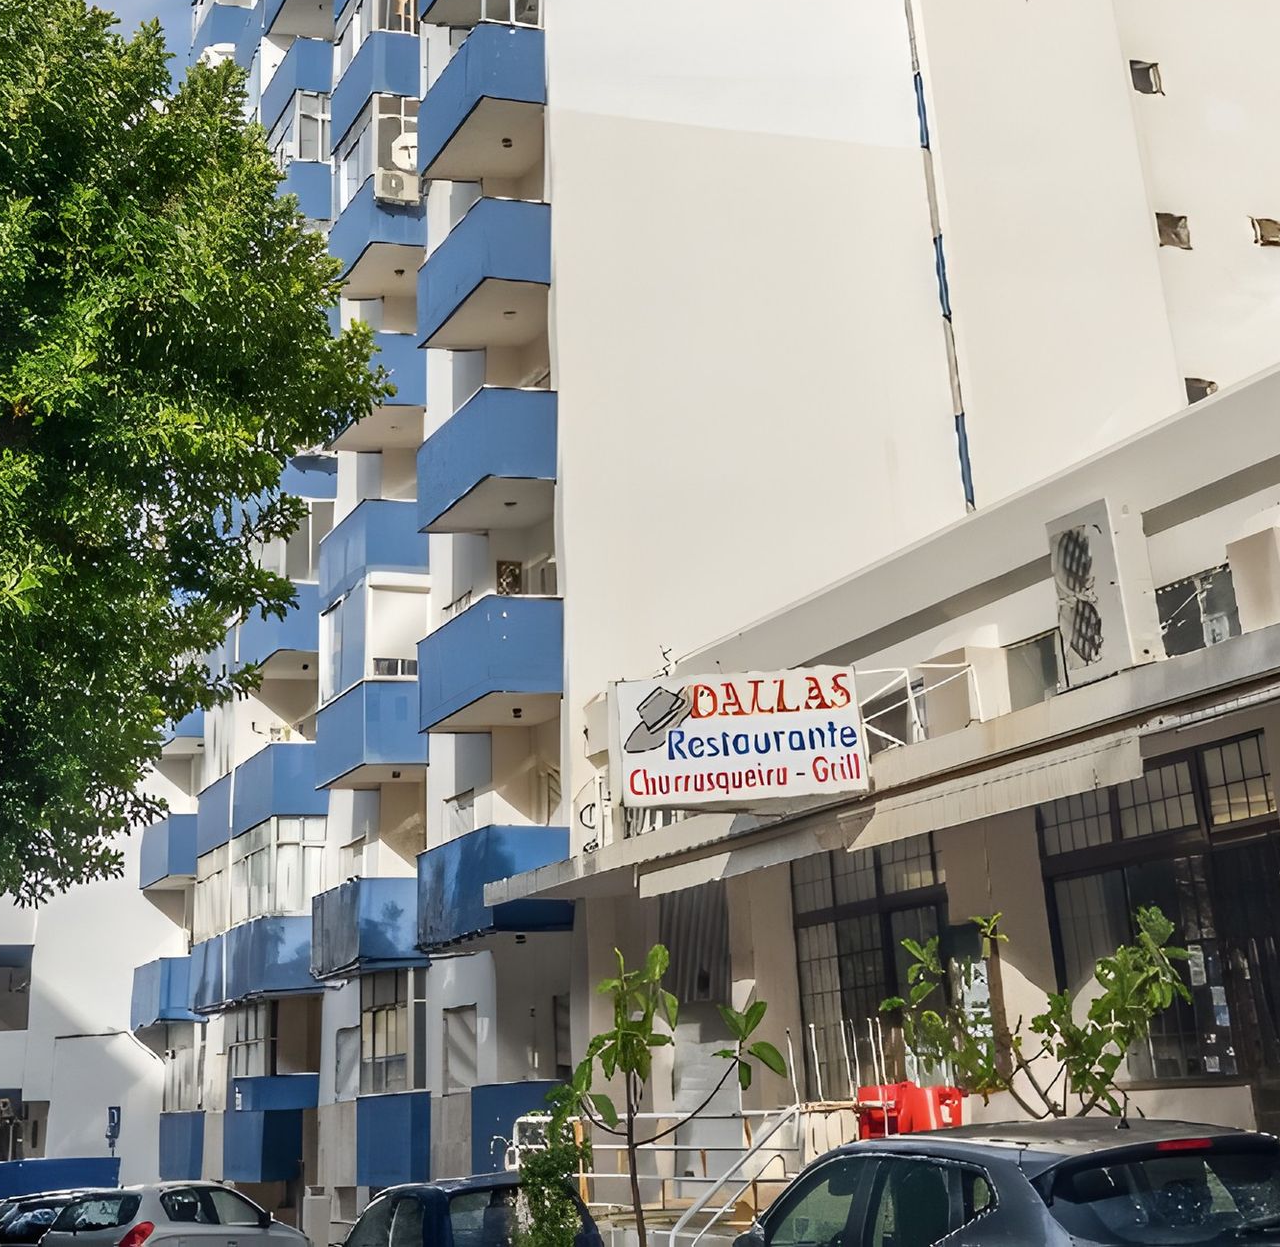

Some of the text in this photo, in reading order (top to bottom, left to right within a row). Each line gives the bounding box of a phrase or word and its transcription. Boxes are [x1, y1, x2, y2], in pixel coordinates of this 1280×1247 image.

[690, 672, 852, 719] DALLAS
[667, 720, 858, 761] Restaurante
[811, 752, 861, 783] Grill
